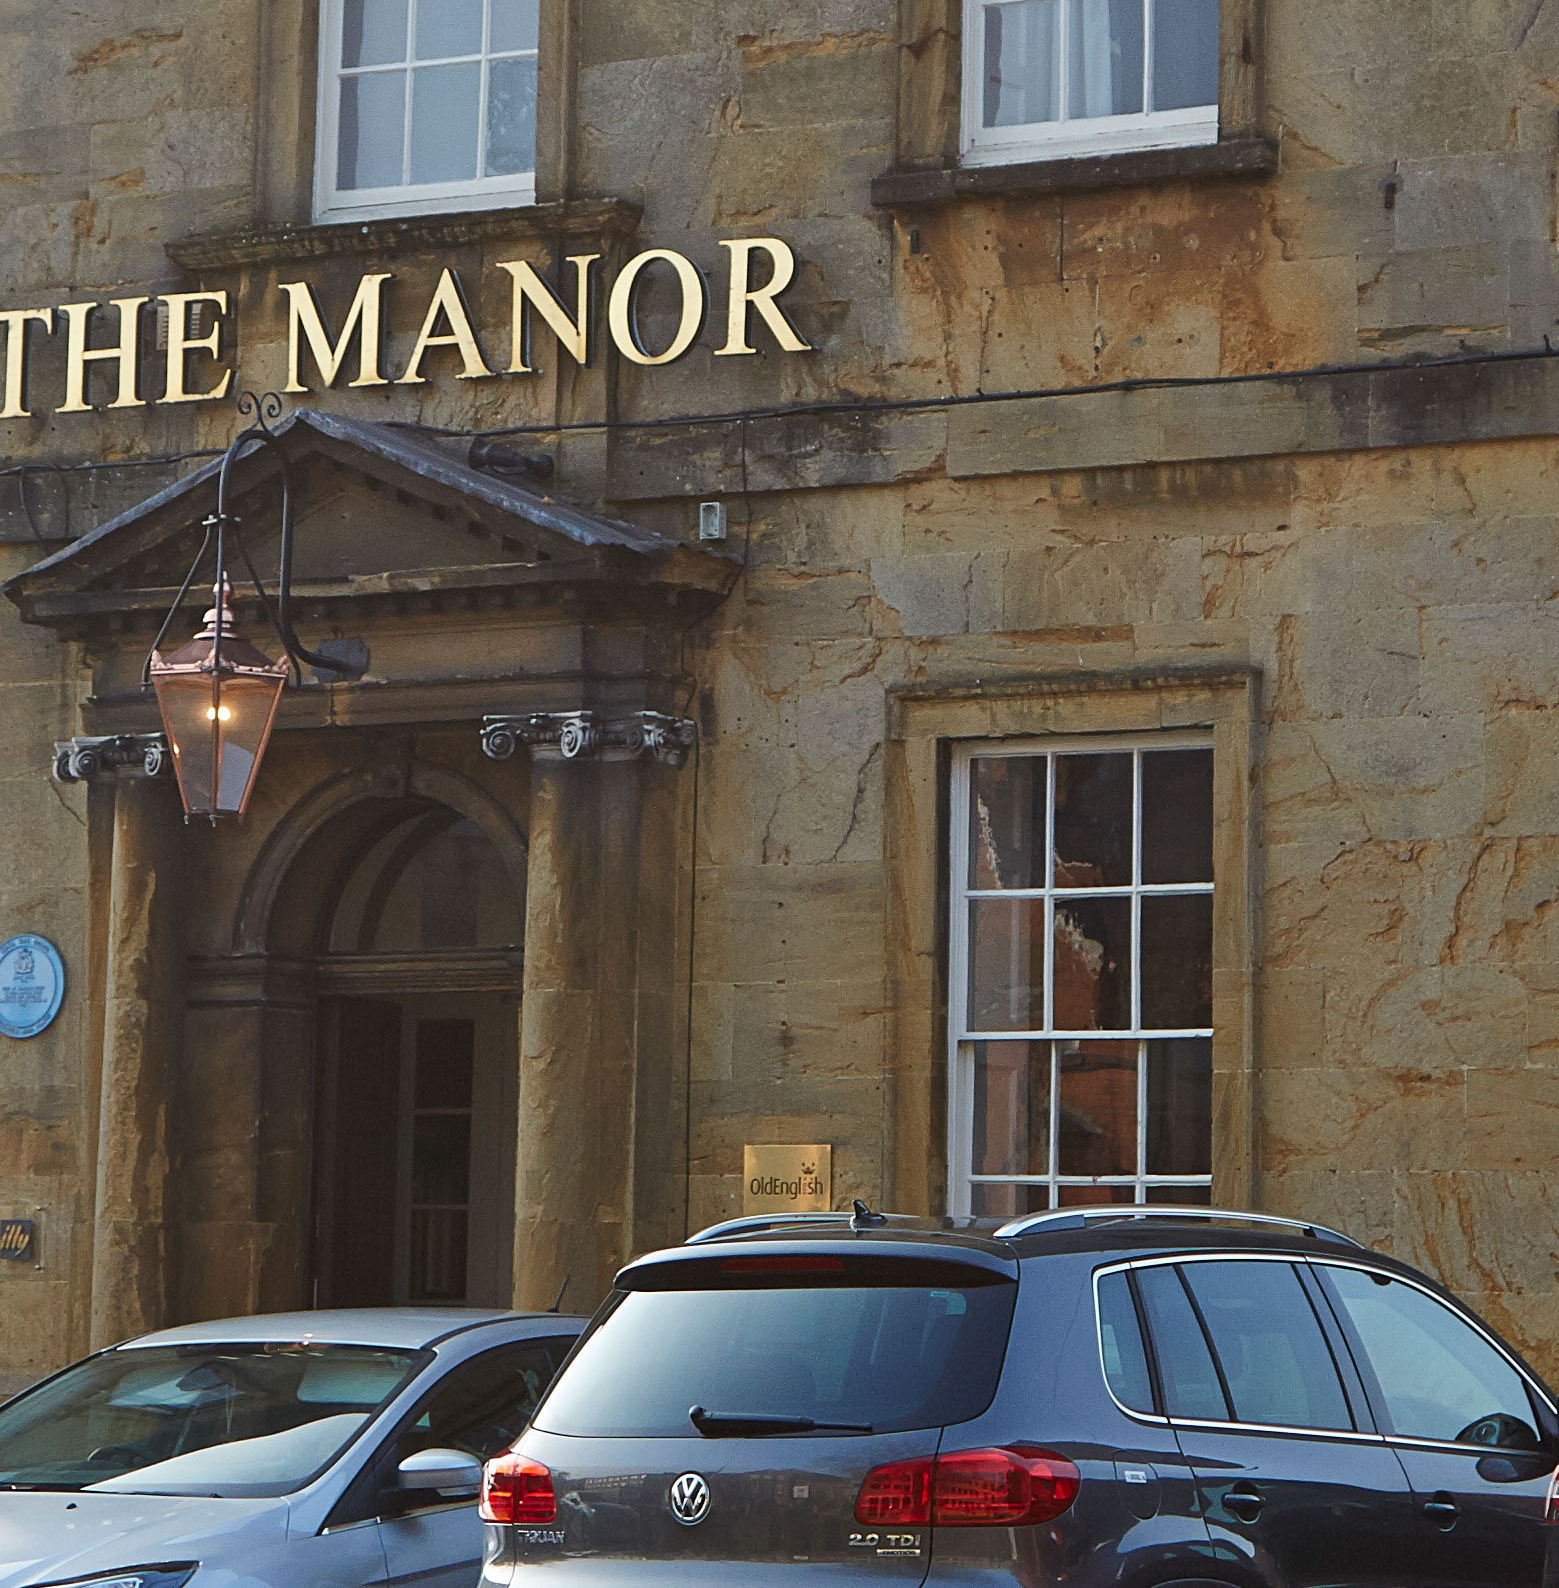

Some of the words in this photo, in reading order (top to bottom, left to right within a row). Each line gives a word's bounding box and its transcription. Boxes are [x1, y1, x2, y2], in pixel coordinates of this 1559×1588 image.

[277, 237, 813, 394] MANOR
[0, 1224, 30, 1256] illy
[886, 1534, 922, 1547] TDI
